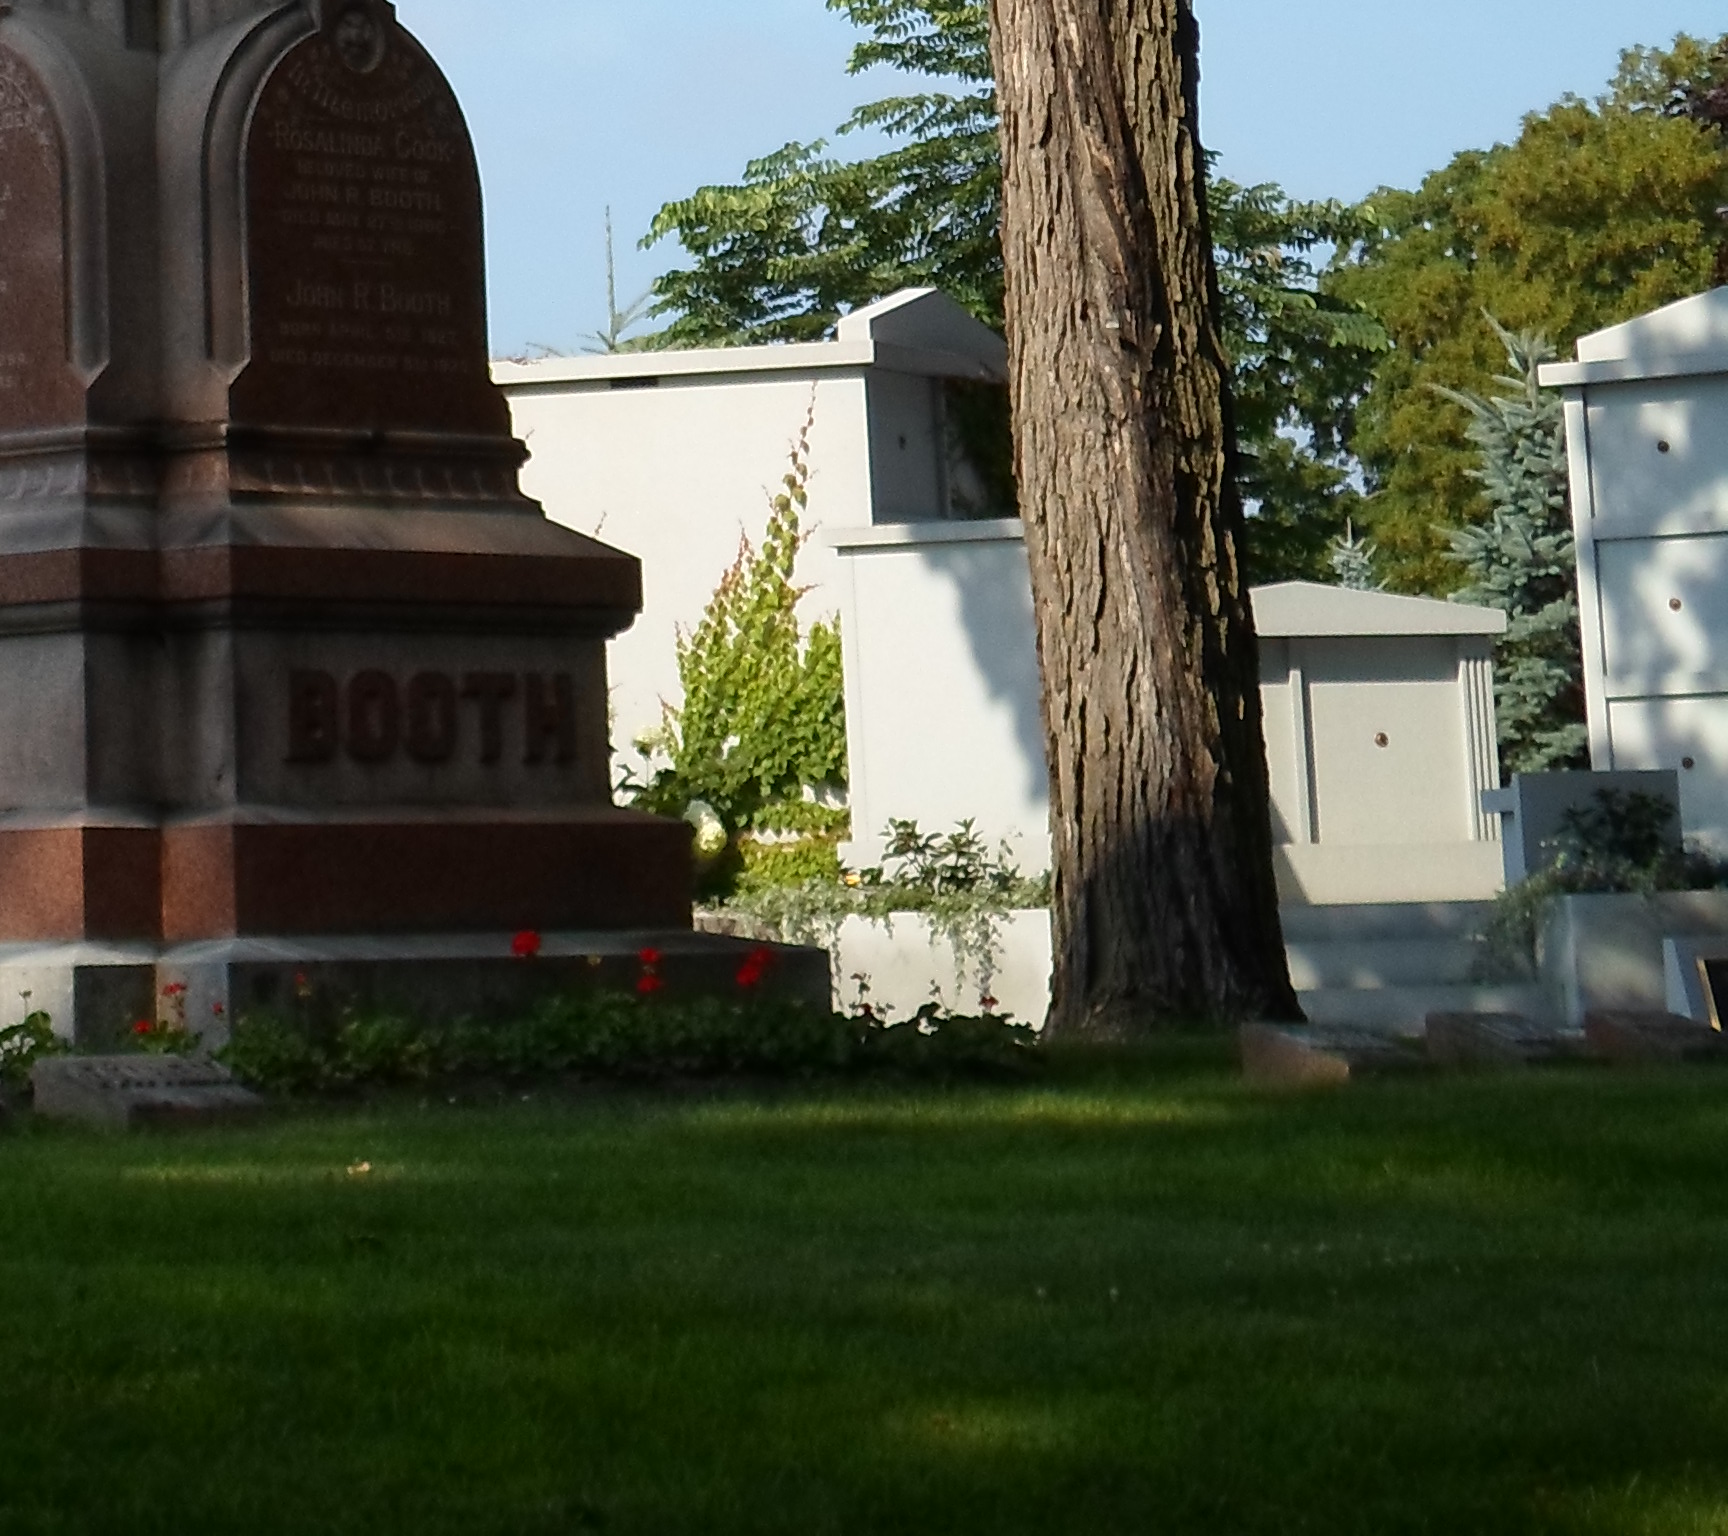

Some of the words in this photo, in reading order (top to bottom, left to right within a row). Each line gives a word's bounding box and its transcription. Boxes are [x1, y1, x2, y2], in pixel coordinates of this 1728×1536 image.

[297, 160, 366, 179] BELOVED
[372, 166, 408, 183] WIFE
[284, 183, 339, 204] JOHN
[370, 188, 442, 212] BOOTH
[286, 277, 344, 310] JOHN
[381, 282, 451, 316] BOOTH
[286, 668, 576, 766] BOOTH
